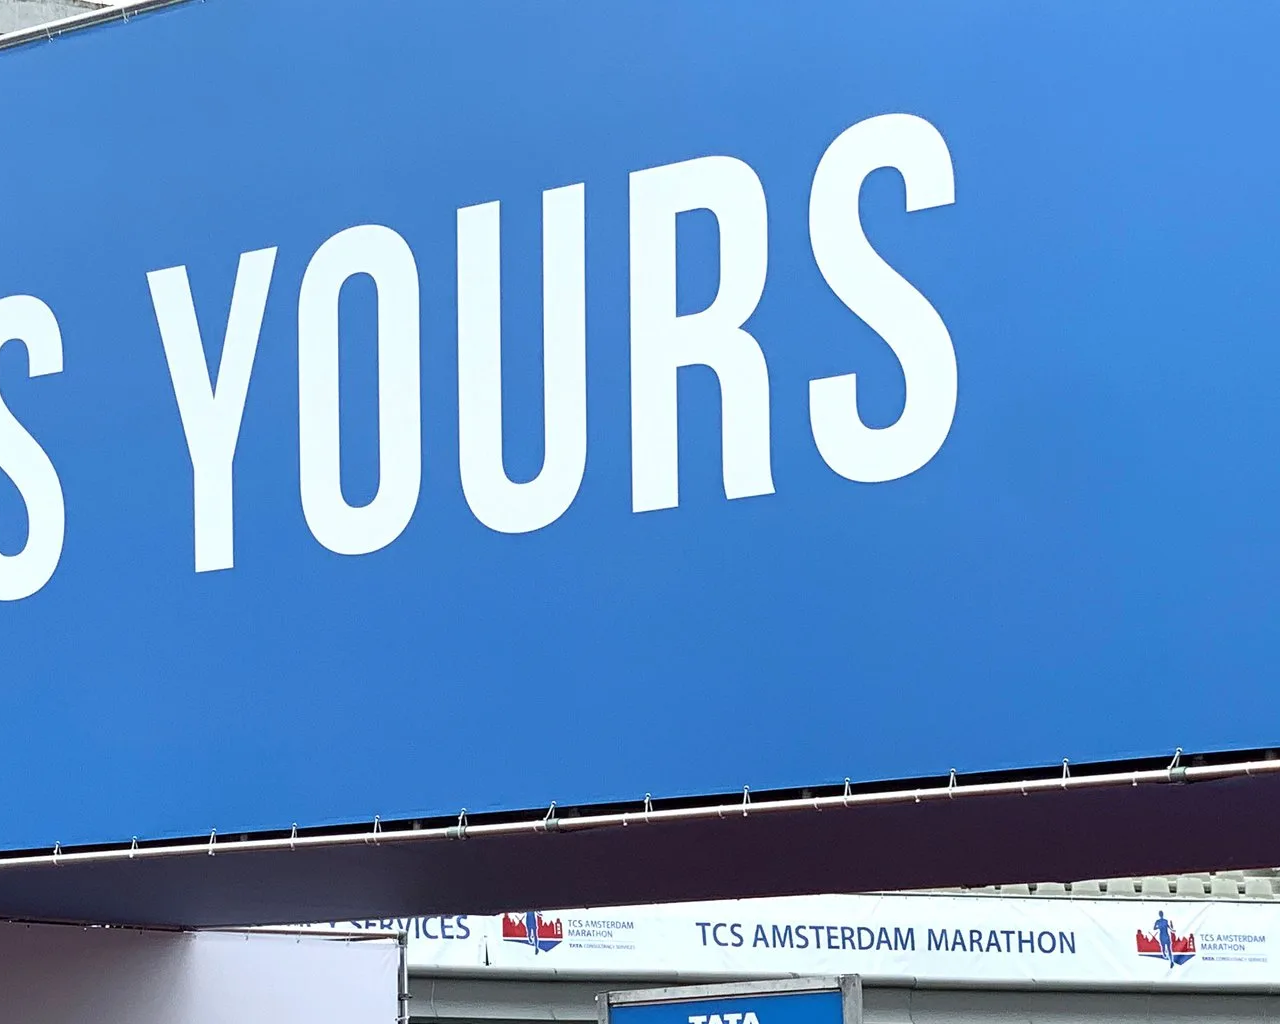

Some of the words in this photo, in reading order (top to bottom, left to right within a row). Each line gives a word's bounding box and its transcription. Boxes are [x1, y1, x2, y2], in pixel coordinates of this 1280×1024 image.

[145, 112, 958, 574] YOURS
[568, 919, 583, 928] TCS
[585, 920, 634, 929] AMSTERDAM
[568, 929, 613, 938] MARATHON
[695, 921, 744, 947] TCS
[752, 922, 916, 952] AMSTERDAM
[927, 928, 1076, 954] MARATHON
[1200, 934, 1214, 942] TCS
[1217, 934, 1266, 943] AMSTERDAM
[1201, 943, 1245, 951] MARATHON
